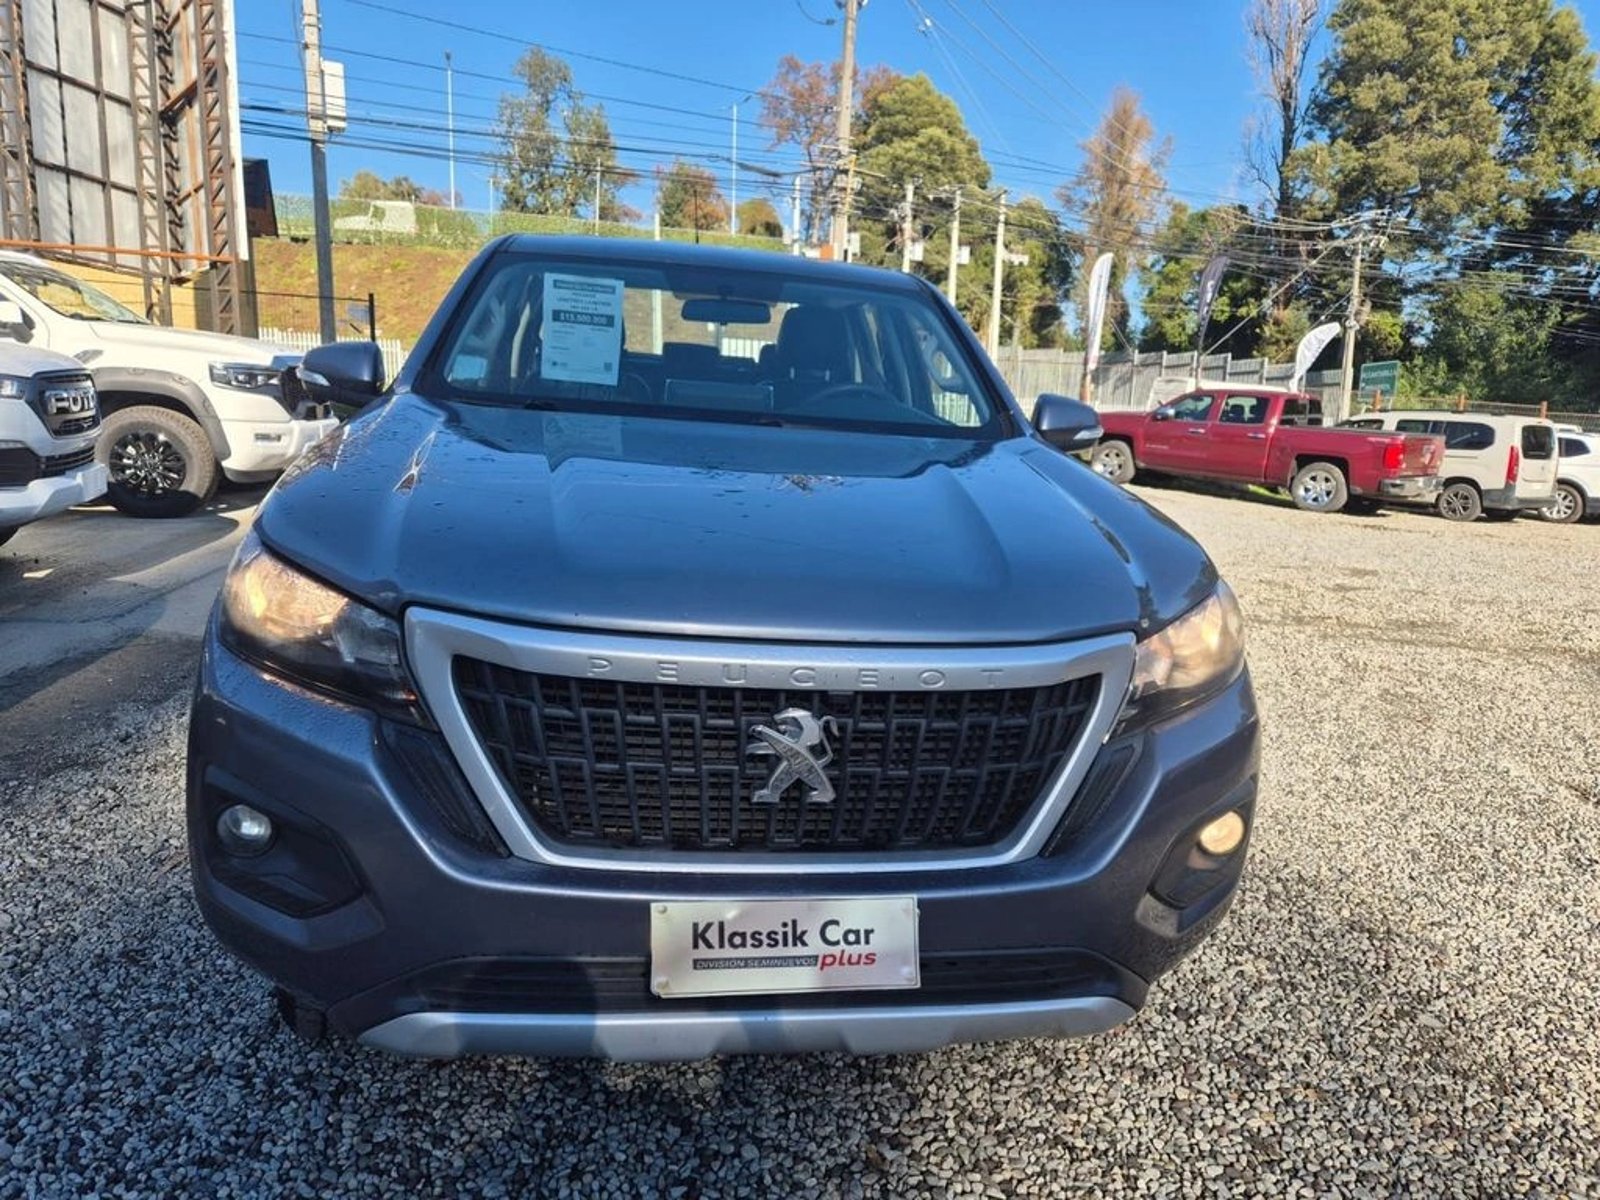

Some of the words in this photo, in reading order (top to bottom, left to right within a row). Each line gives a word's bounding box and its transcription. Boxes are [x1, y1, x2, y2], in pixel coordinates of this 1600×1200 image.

[586, 656, 1004, 689] PEUGEOT
[692, 918, 809, 950] Klassik
[819, 919, 875, 947] Car
[748, 957, 816, 968] SEMINUEVOS
[819, 949, 877, 971] plus
